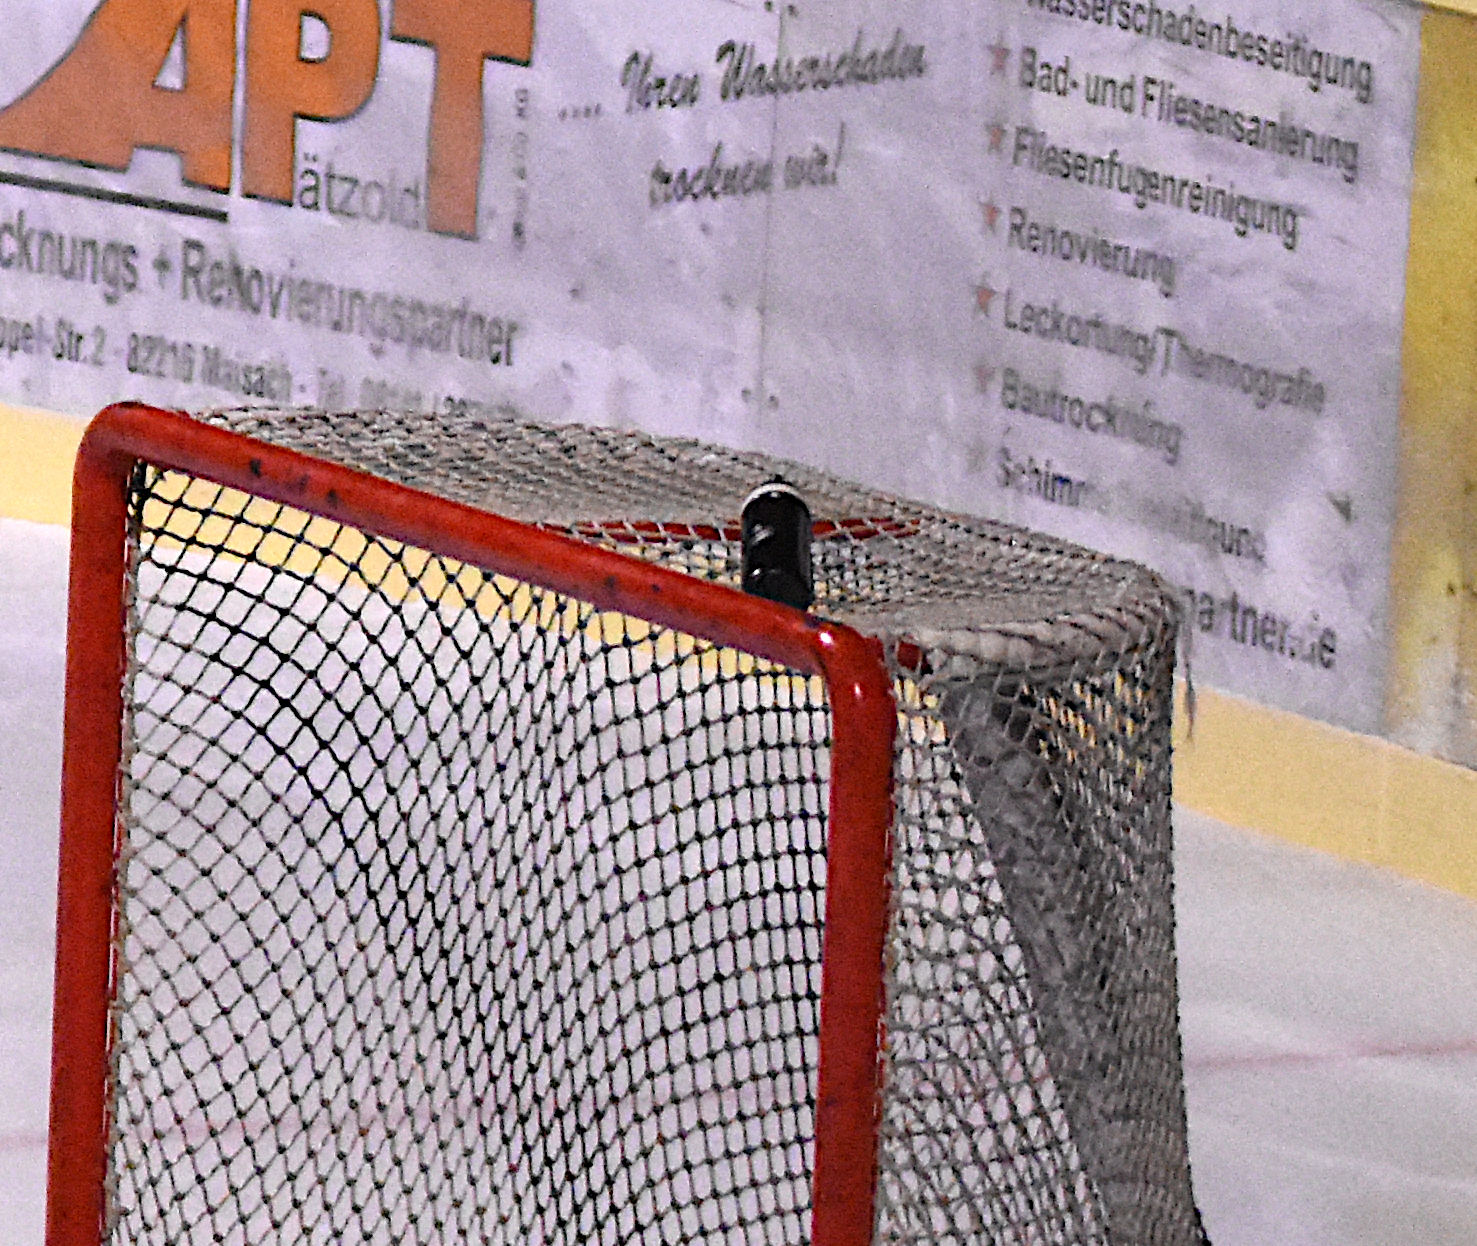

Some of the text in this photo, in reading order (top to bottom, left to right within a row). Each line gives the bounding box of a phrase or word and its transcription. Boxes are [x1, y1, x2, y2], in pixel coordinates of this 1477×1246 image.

[715, 27, 926, 102] Wasserschaden
[1020, 46, 1360, 184] Bad- und Fliesensanierung
[1012, 125, 1300, 251] Fliesenfugenreinigung
[1007, 205, 1177, 299] Renovierung
